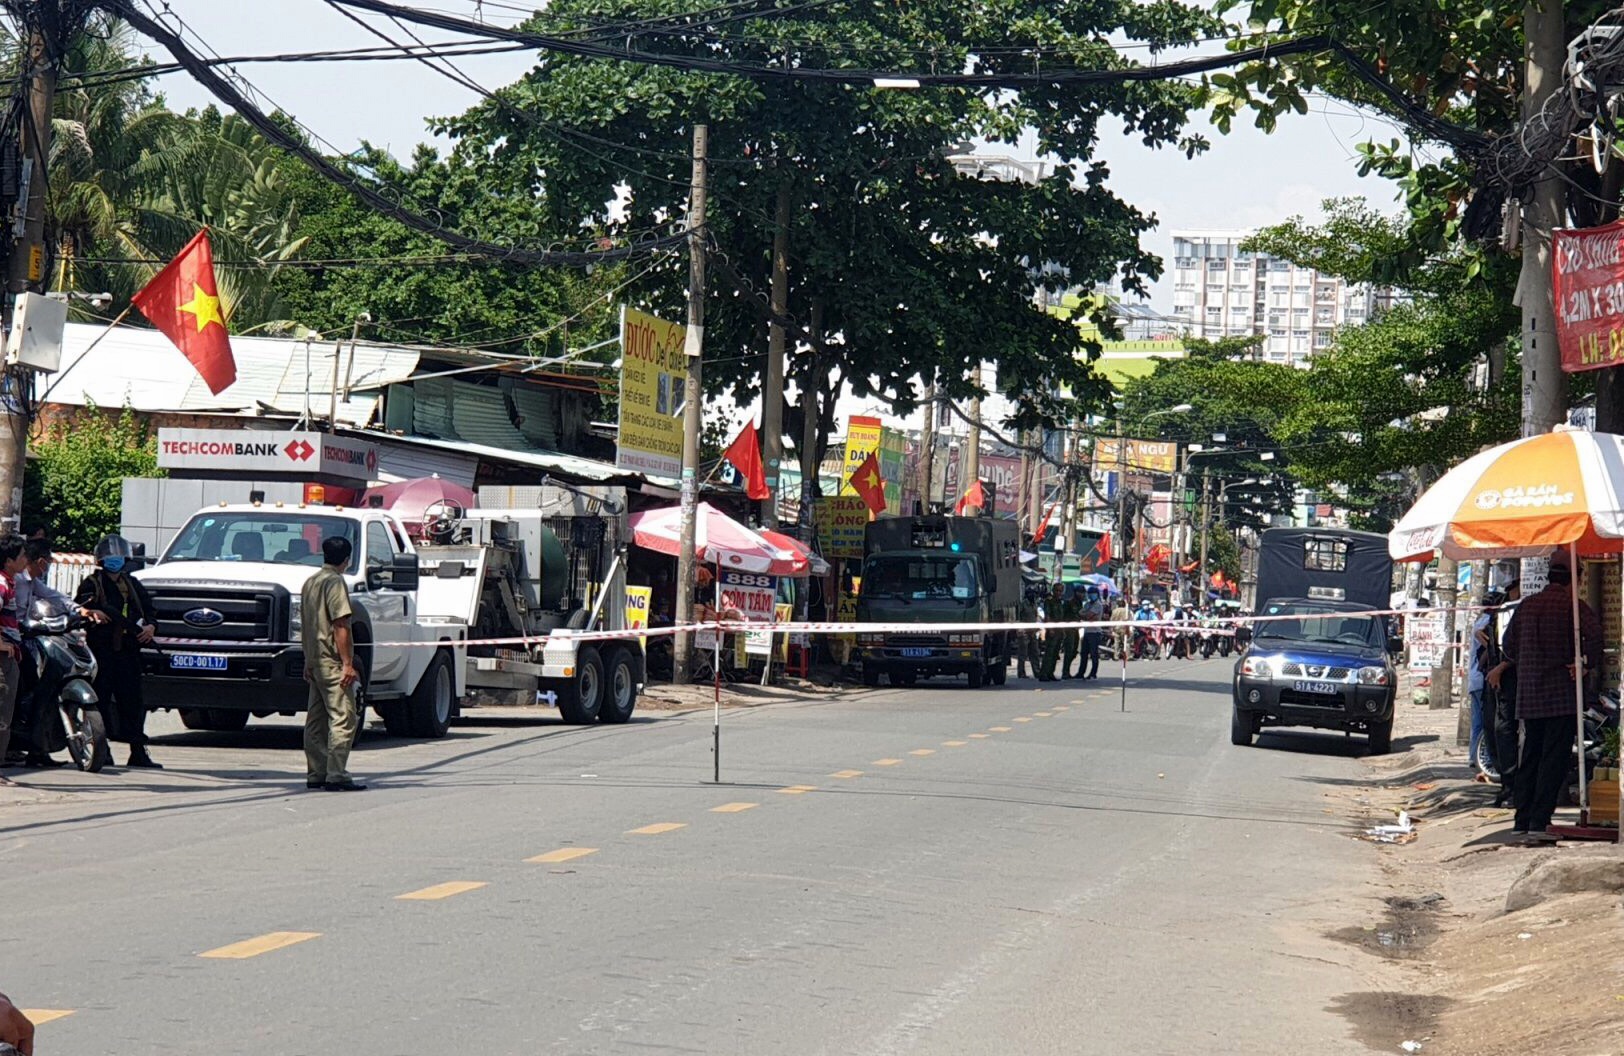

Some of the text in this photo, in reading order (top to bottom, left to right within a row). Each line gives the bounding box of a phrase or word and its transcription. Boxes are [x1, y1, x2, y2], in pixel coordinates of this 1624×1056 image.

[162, 441, 278, 456] TECHCOMBANK
[324, 445, 365, 465] TECHCOMBANK
[726, 572, 771, 587] 888
[721, 588, 772, 612] CƠM TẤM
[173, 656, 224, 667] 50CD-001.17
